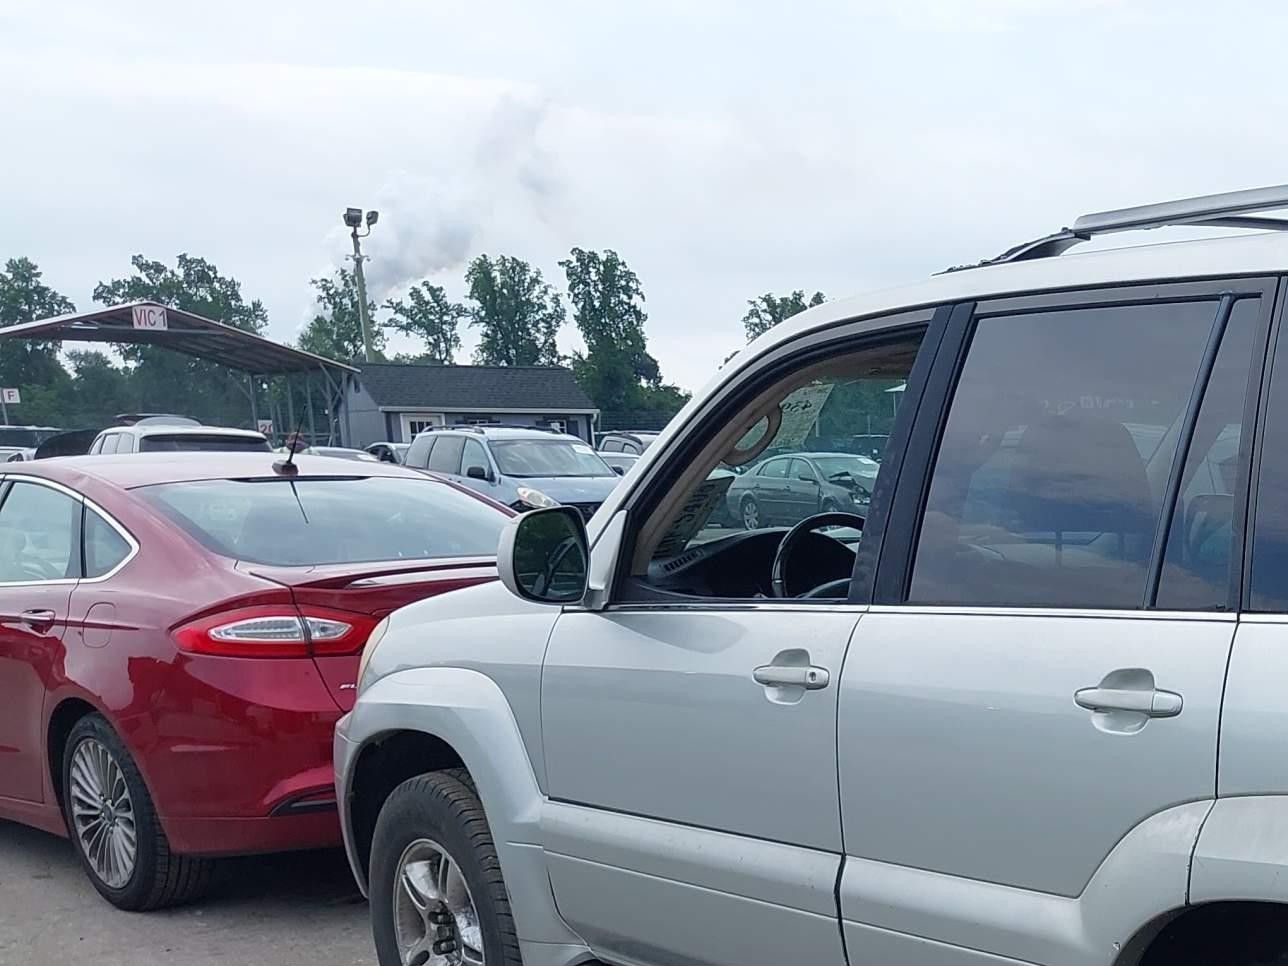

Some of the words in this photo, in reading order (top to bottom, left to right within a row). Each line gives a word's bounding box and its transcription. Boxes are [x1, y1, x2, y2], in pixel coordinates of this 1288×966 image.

[134, 308, 157, 327] VIC
[159, 310, 167, 327] 1
[7, 390, 15, 401] F
